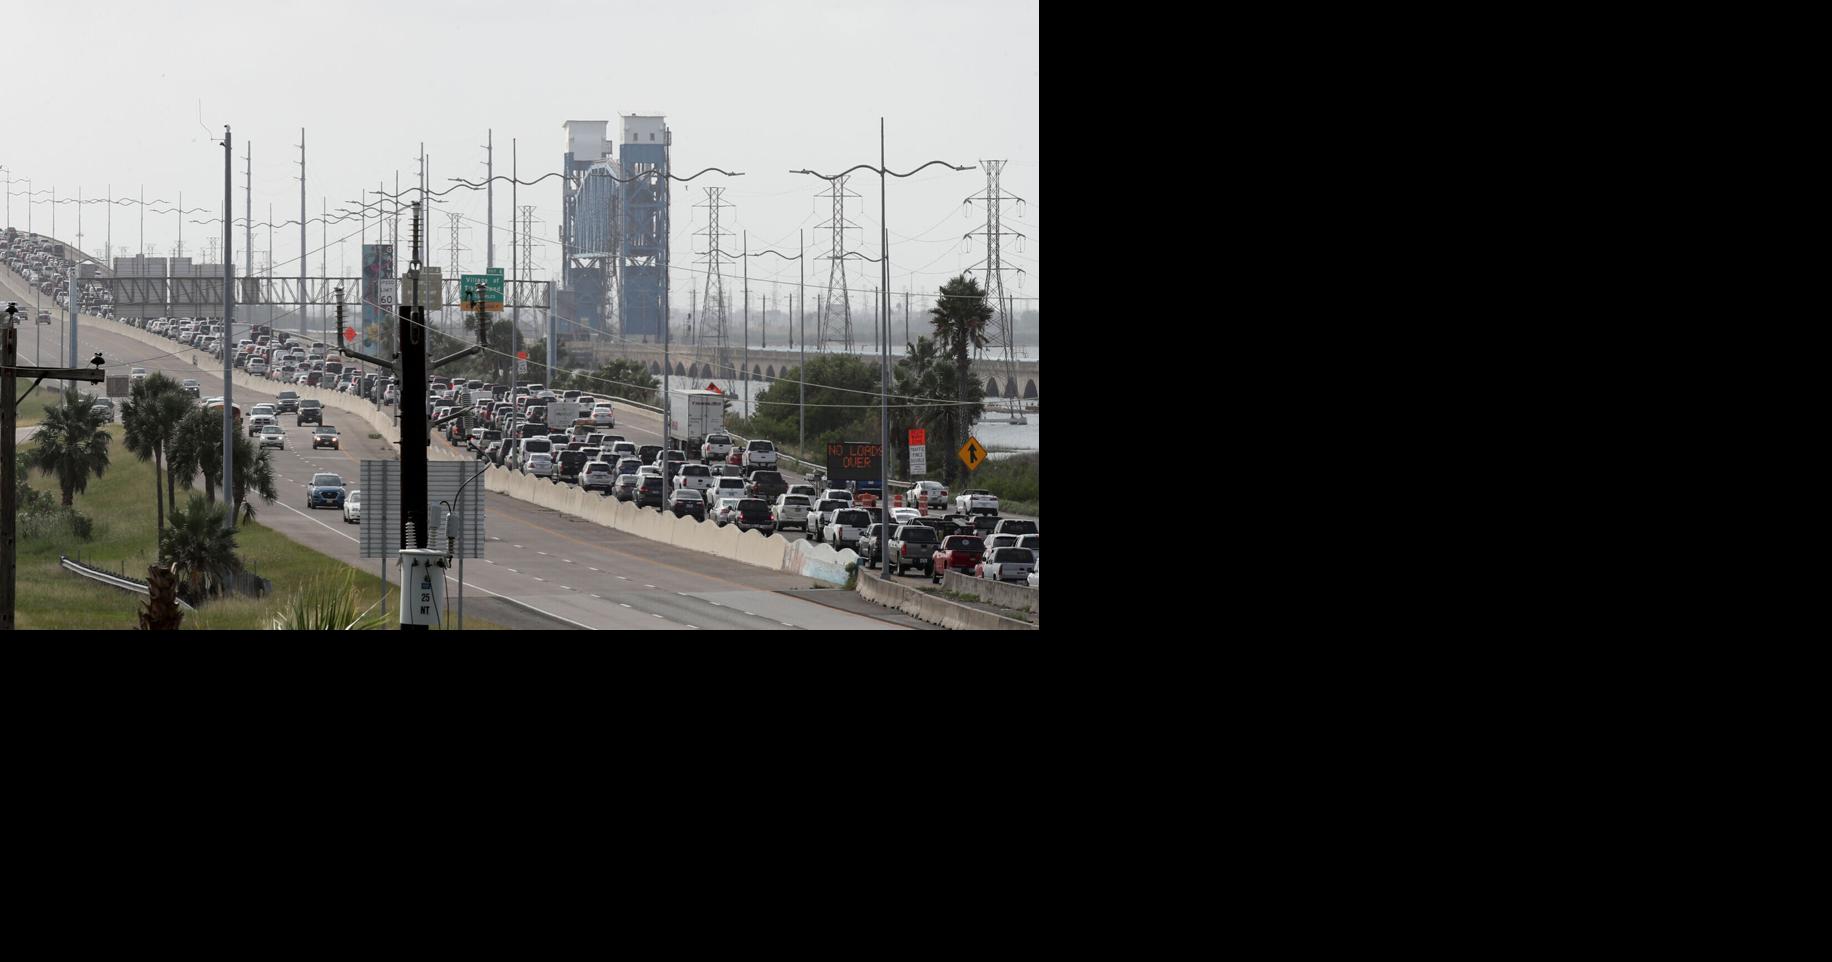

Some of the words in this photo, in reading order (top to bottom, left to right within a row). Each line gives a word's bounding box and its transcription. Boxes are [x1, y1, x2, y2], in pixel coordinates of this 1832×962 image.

[380, 295, 393, 304] 60
[828, 445, 843, 456] NO
[842, 456, 872, 468] OVER
[421, 593, 430, 602] 25
[420, 605, 430, 615] NT
